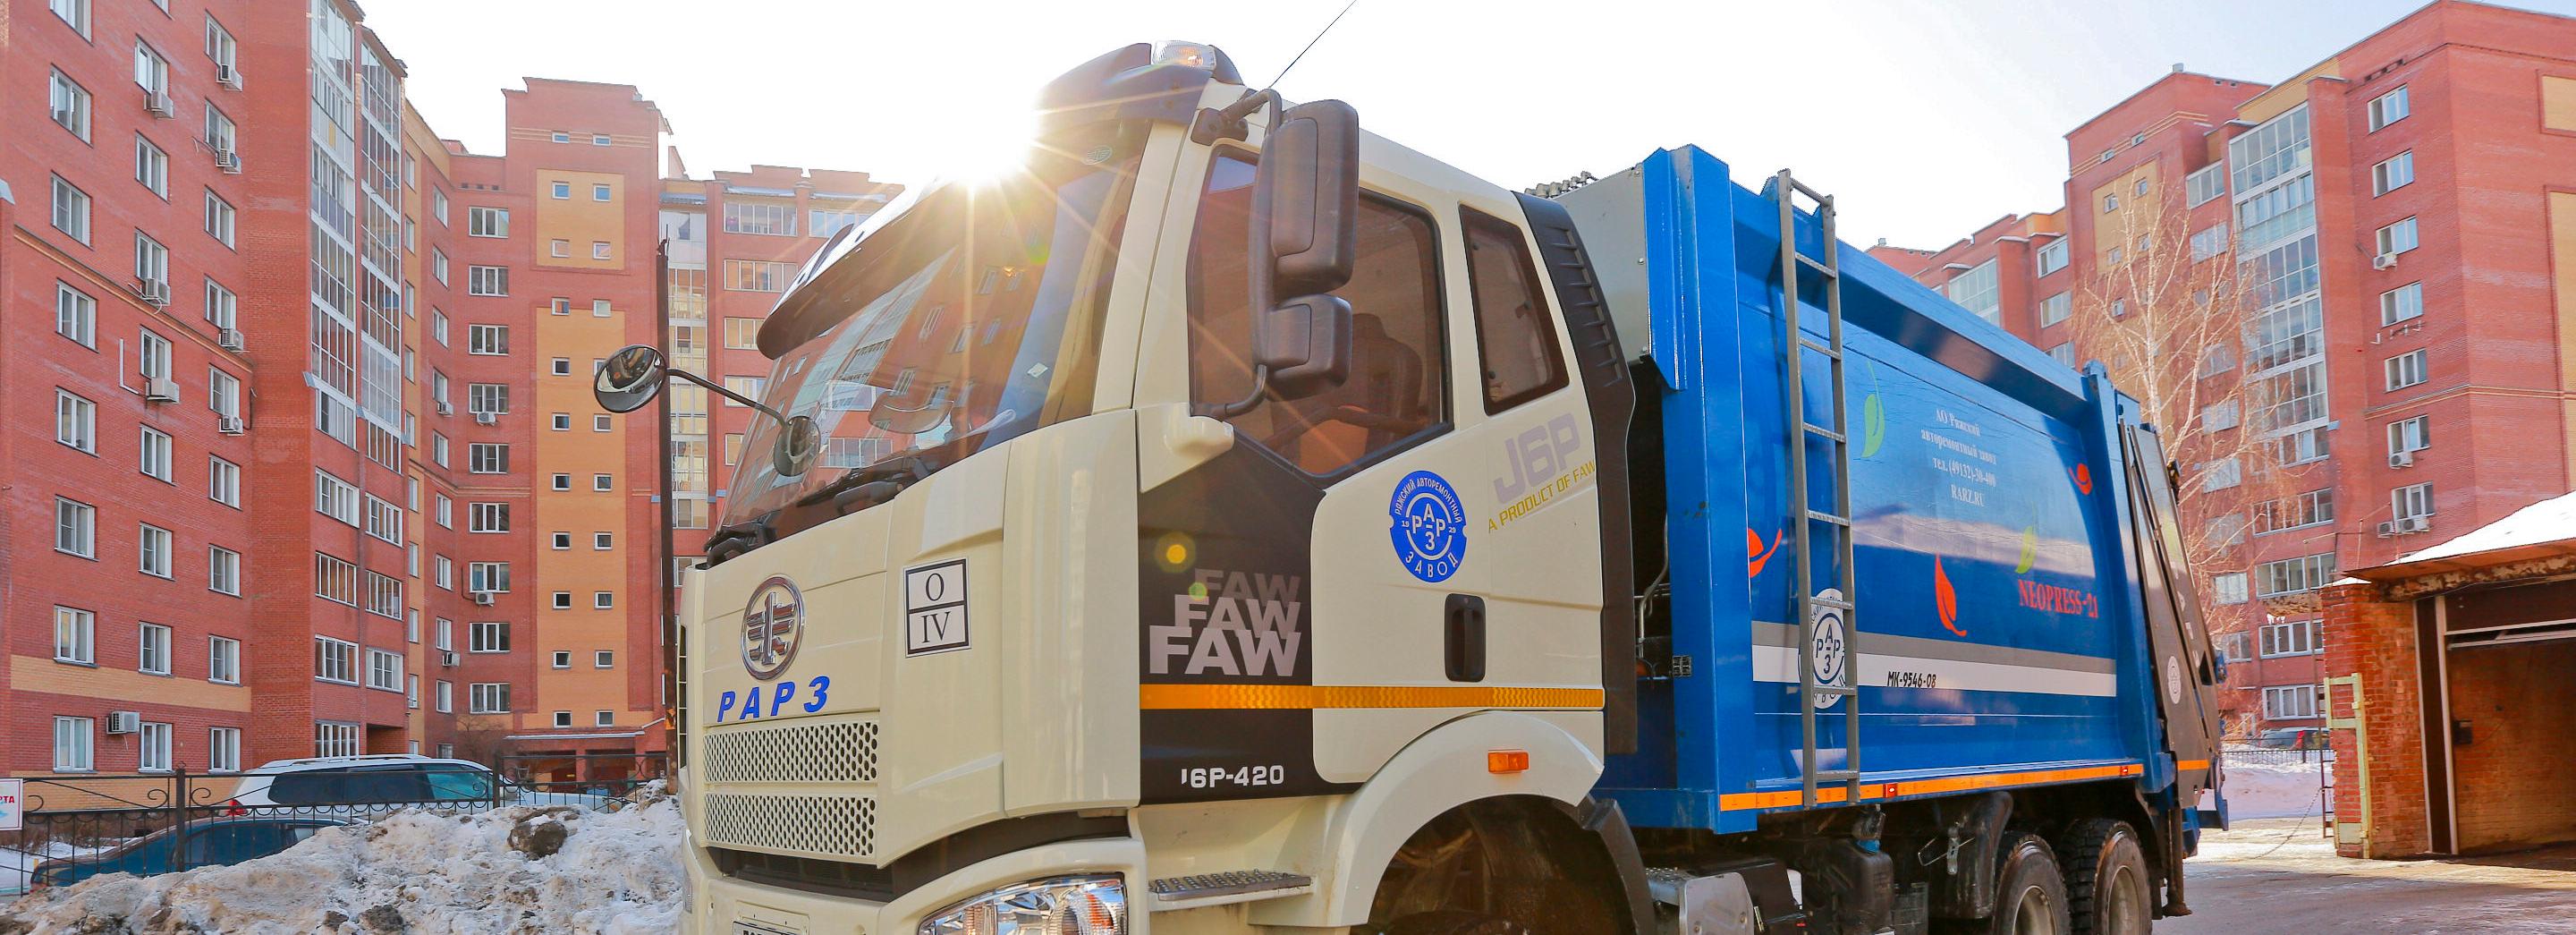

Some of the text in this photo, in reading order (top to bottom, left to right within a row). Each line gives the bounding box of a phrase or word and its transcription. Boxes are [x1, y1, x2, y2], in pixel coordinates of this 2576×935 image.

[1494, 412, 1580, 504] J6P
[1920, 429, 1979, 458] авторемонтный
[1394, 477, 1463, 523] РЯЖСКИЙ АВТОРЕМОНТНЫЙ
[1488, 458, 1595, 533] A PRODUCT OF FAW
[1951, 484, 1985, 507] RARZ.RU
[1402, 520, 1411, 528] 19
[1448, 526, 1457, 534] 29
[1405, 551, 1459, 578] ЗАВОД
[1195, 567, 1301, 608] FAW
[2018, 579, 2099, 619] NEOPRESS-21
[921, 611, 951, 643] IV
[1174, 594, 1301, 639] FAW
[1149, 625, 1301, 677] FAW
